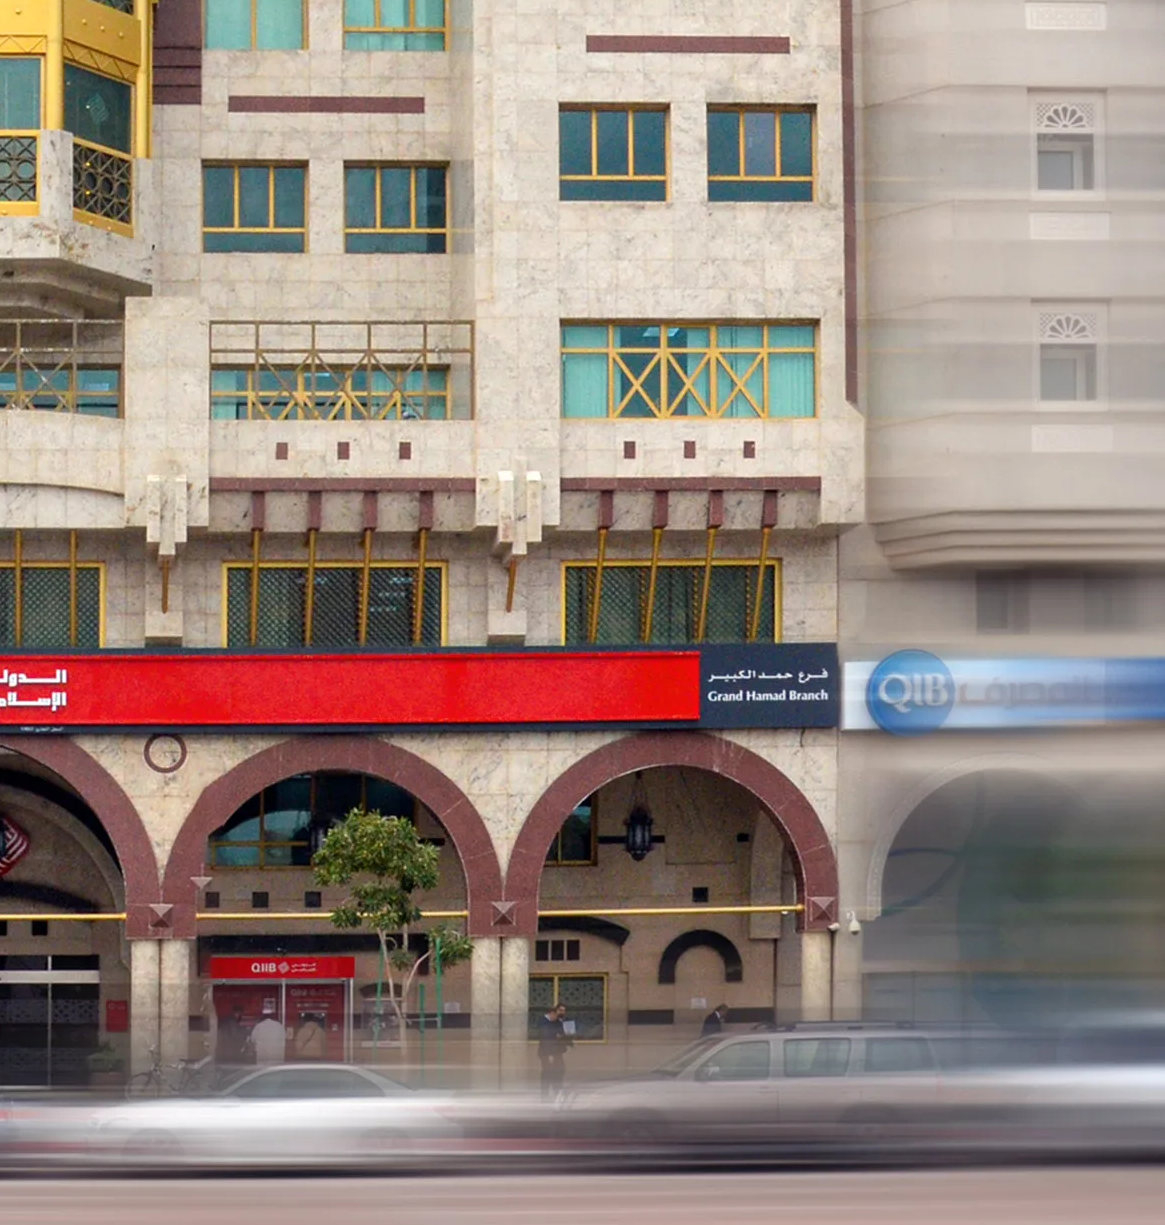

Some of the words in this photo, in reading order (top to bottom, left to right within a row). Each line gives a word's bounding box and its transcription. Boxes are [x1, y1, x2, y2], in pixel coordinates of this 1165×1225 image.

[708, 669, 756, 682] الكبير
[758, 671, 793, 679] حمد
[798, 668, 829, 683] فرع
[707, 689, 743, 701] Grand
[746, 688, 786, 701] Hamad
[788, 688, 829, 701] Branch
[878, 672, 949, 713] QIB
[251, 962, 277, 973] QIIB
